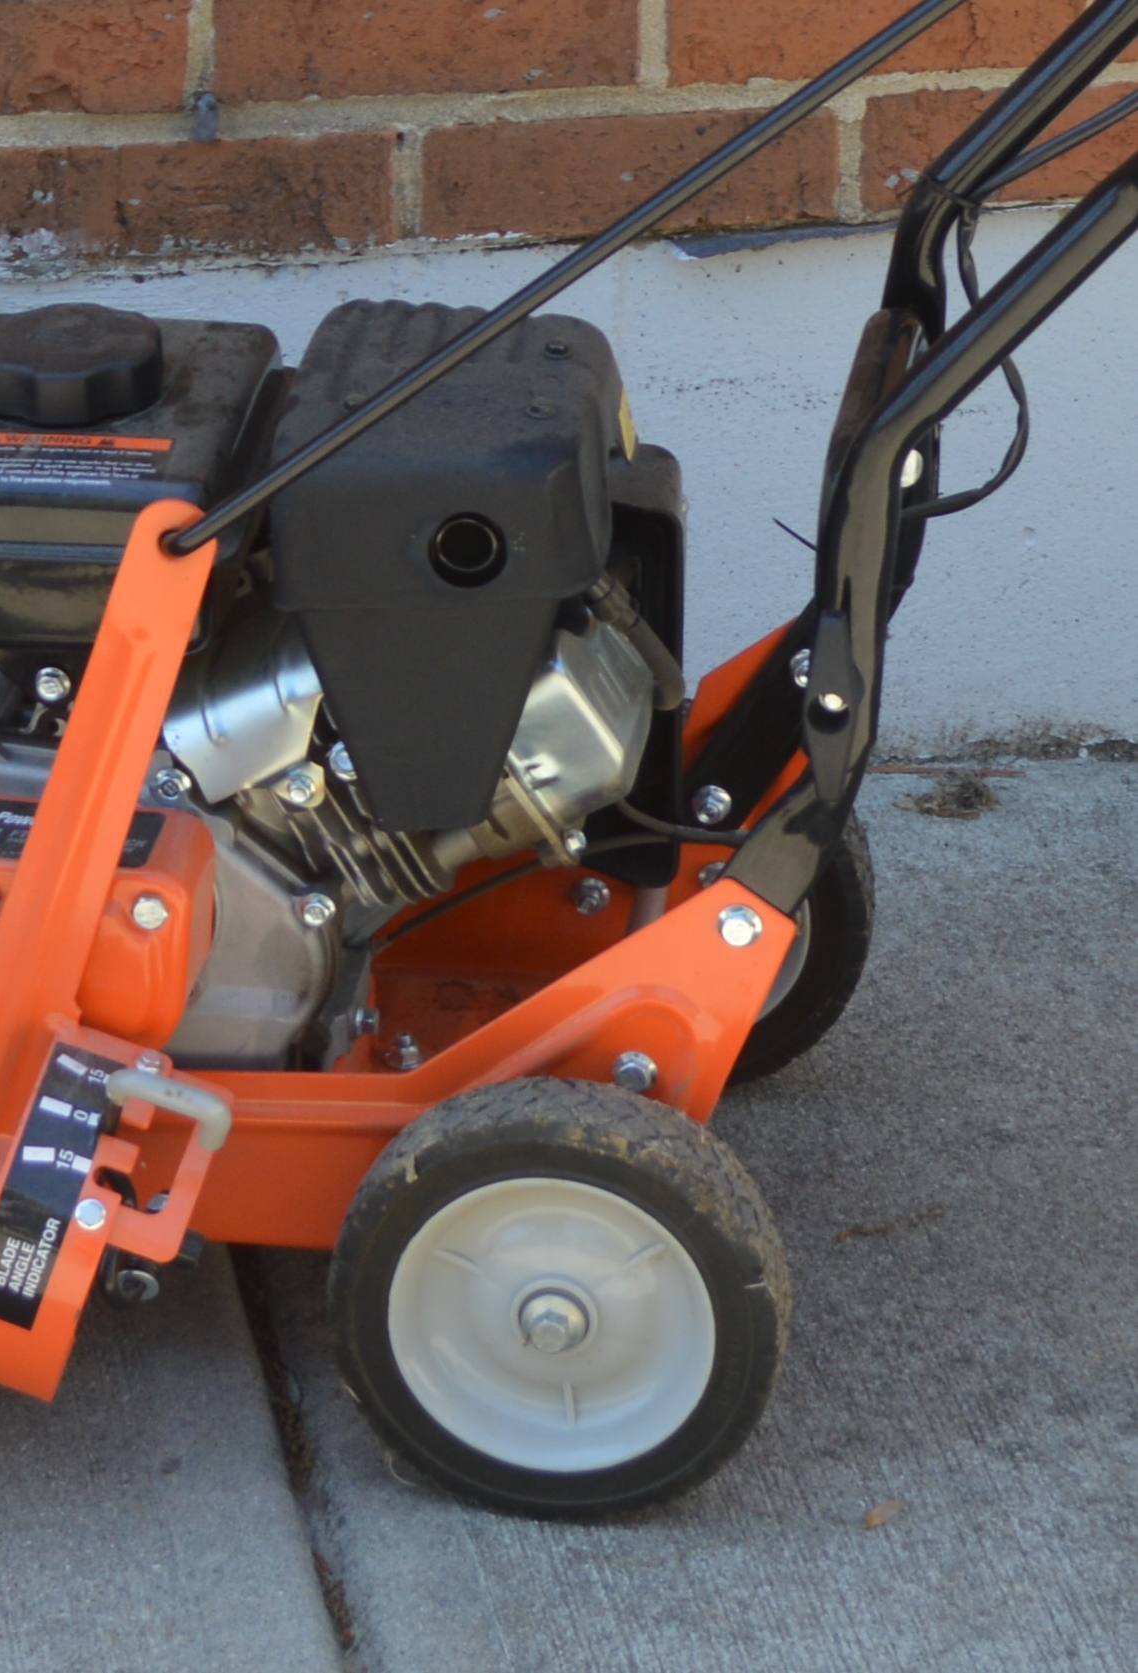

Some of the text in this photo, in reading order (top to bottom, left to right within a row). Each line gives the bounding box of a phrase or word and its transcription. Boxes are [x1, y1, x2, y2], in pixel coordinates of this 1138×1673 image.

[87, 1068, 105, 1083] 15
[73, 1109, 89, 1122] 0
[56, 1148, 75, 1169] 15
[8, 1241, 36, 1293] ANGLE
[21, 1217, 62, 1298] INDICATOR
